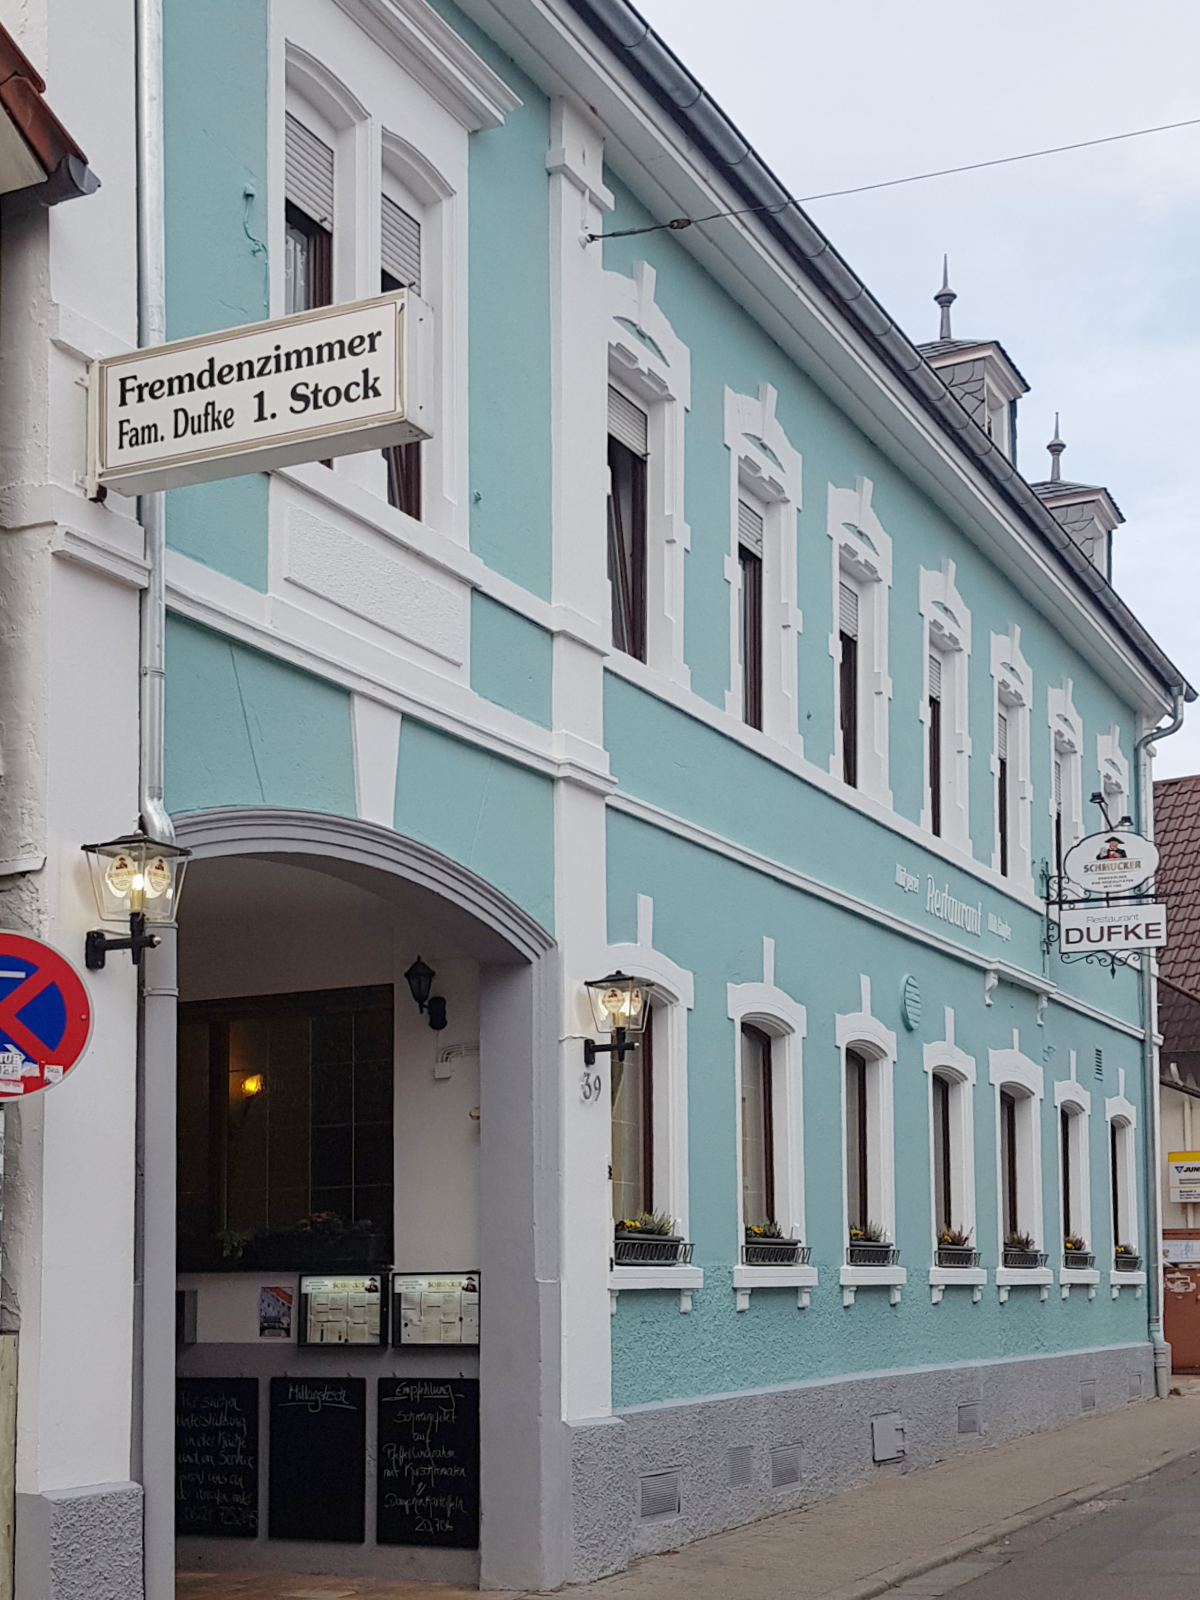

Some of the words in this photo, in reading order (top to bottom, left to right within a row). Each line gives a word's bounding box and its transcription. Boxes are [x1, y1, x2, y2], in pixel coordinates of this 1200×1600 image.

[118, 330, 383, 407] Fremdenzimmer
[118, 418, 165, 450] Fam.
[173, 401, 235, 439] Dufke
[252, 390, 278, 423] 1.
[288, 367, 383, 415] Stock
[1083, 860, 1142, 873] SCHMUCKER
[1085, 913, 1140, 924] Restaurant
[1064, 922, 1162, 945] DUFKE
[580, 1071, 602, 1102] 39
